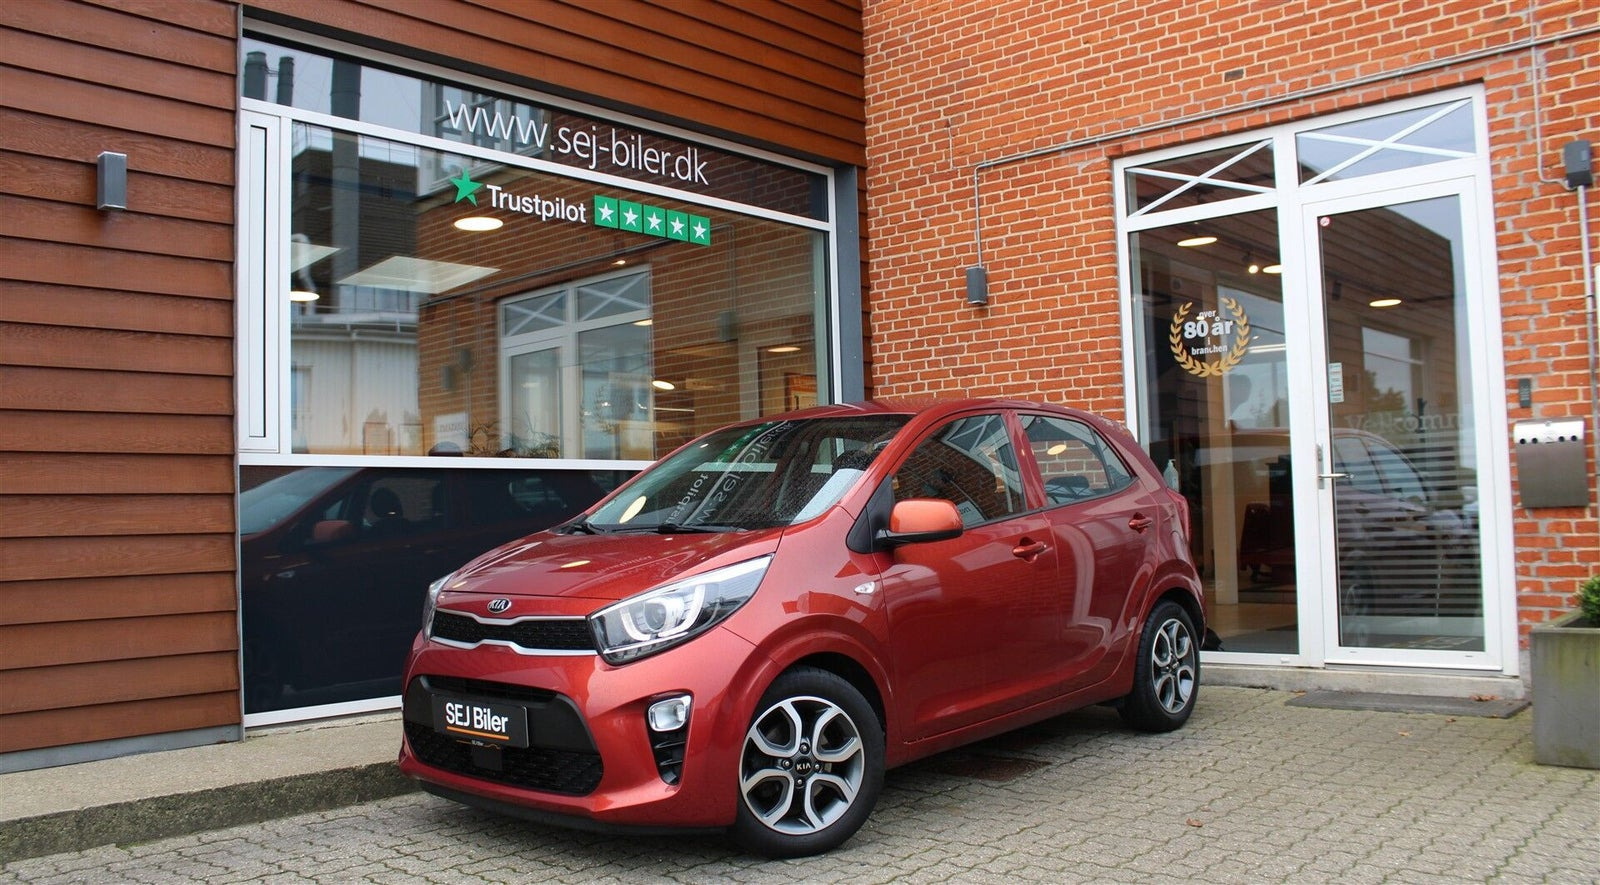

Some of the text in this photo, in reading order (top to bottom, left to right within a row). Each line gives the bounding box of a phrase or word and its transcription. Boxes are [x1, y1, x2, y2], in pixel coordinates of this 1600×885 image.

[446, 100, 709, 185] www.sej-biler.dk
[487, 184, 587, 224] Trustpilot
[1198, 310, 1217, 319] over
[1184, 316, 1233, 339] 80 år
[1191, 345, 1228, 356] branchen
[489, 599, 507, 610] KIA
[445, 702, 509, 733] SEJ Biler
[797, 762, 811, 770] KIA
